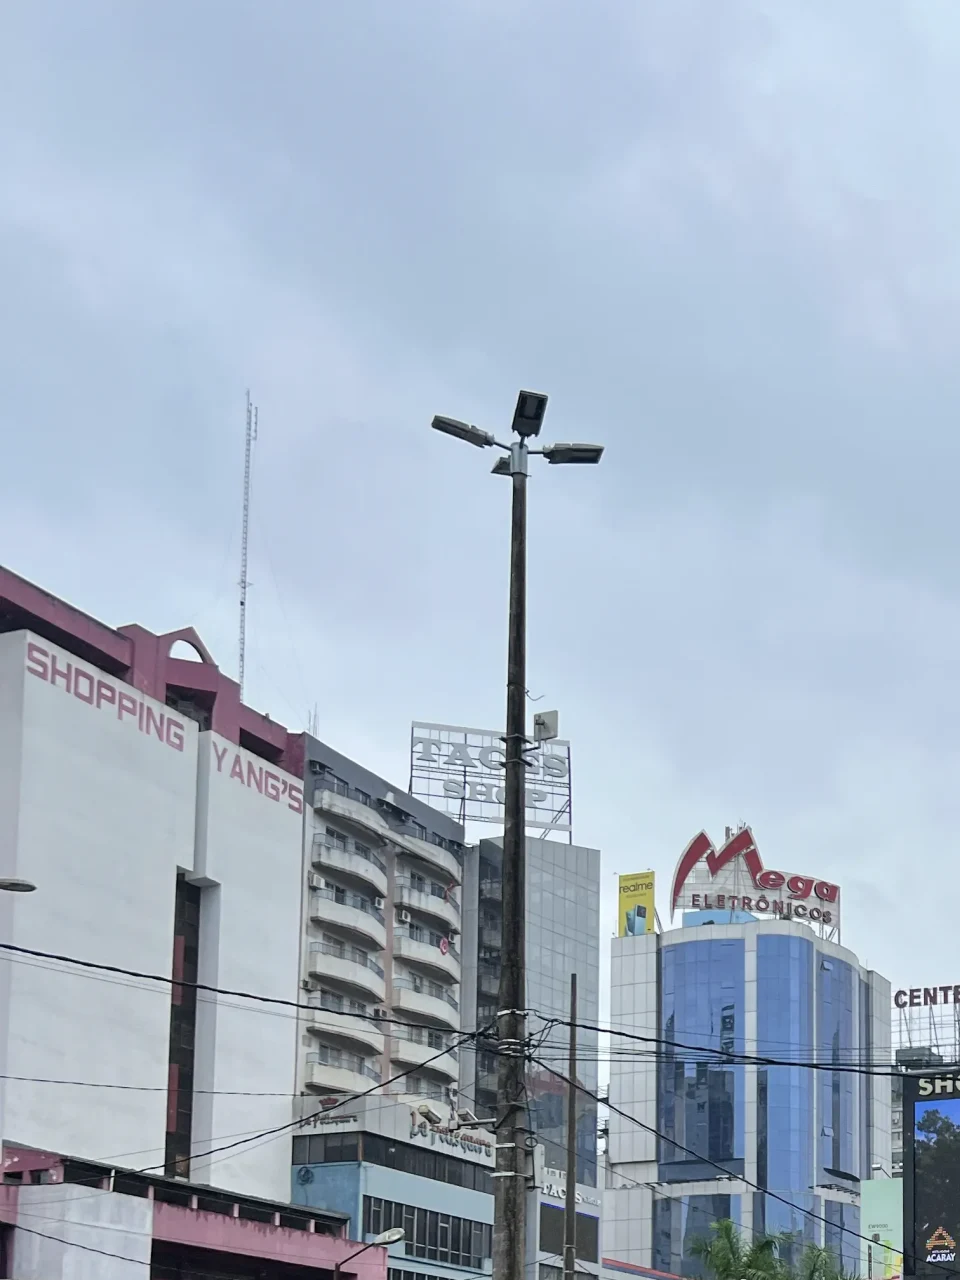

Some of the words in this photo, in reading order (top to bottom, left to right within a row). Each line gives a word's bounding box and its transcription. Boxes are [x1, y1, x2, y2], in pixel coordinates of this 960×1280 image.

[26, 641, 185, 752] SHOPPING
[212, 741, 304, 815] YANG'S
[619, 882, 653, 894] realme
[670, 825, 840, 924] Mega
[691, 893, 833, 924] ELETRÔNICOS
[925, 1252, 957, 1263] ACARAY
